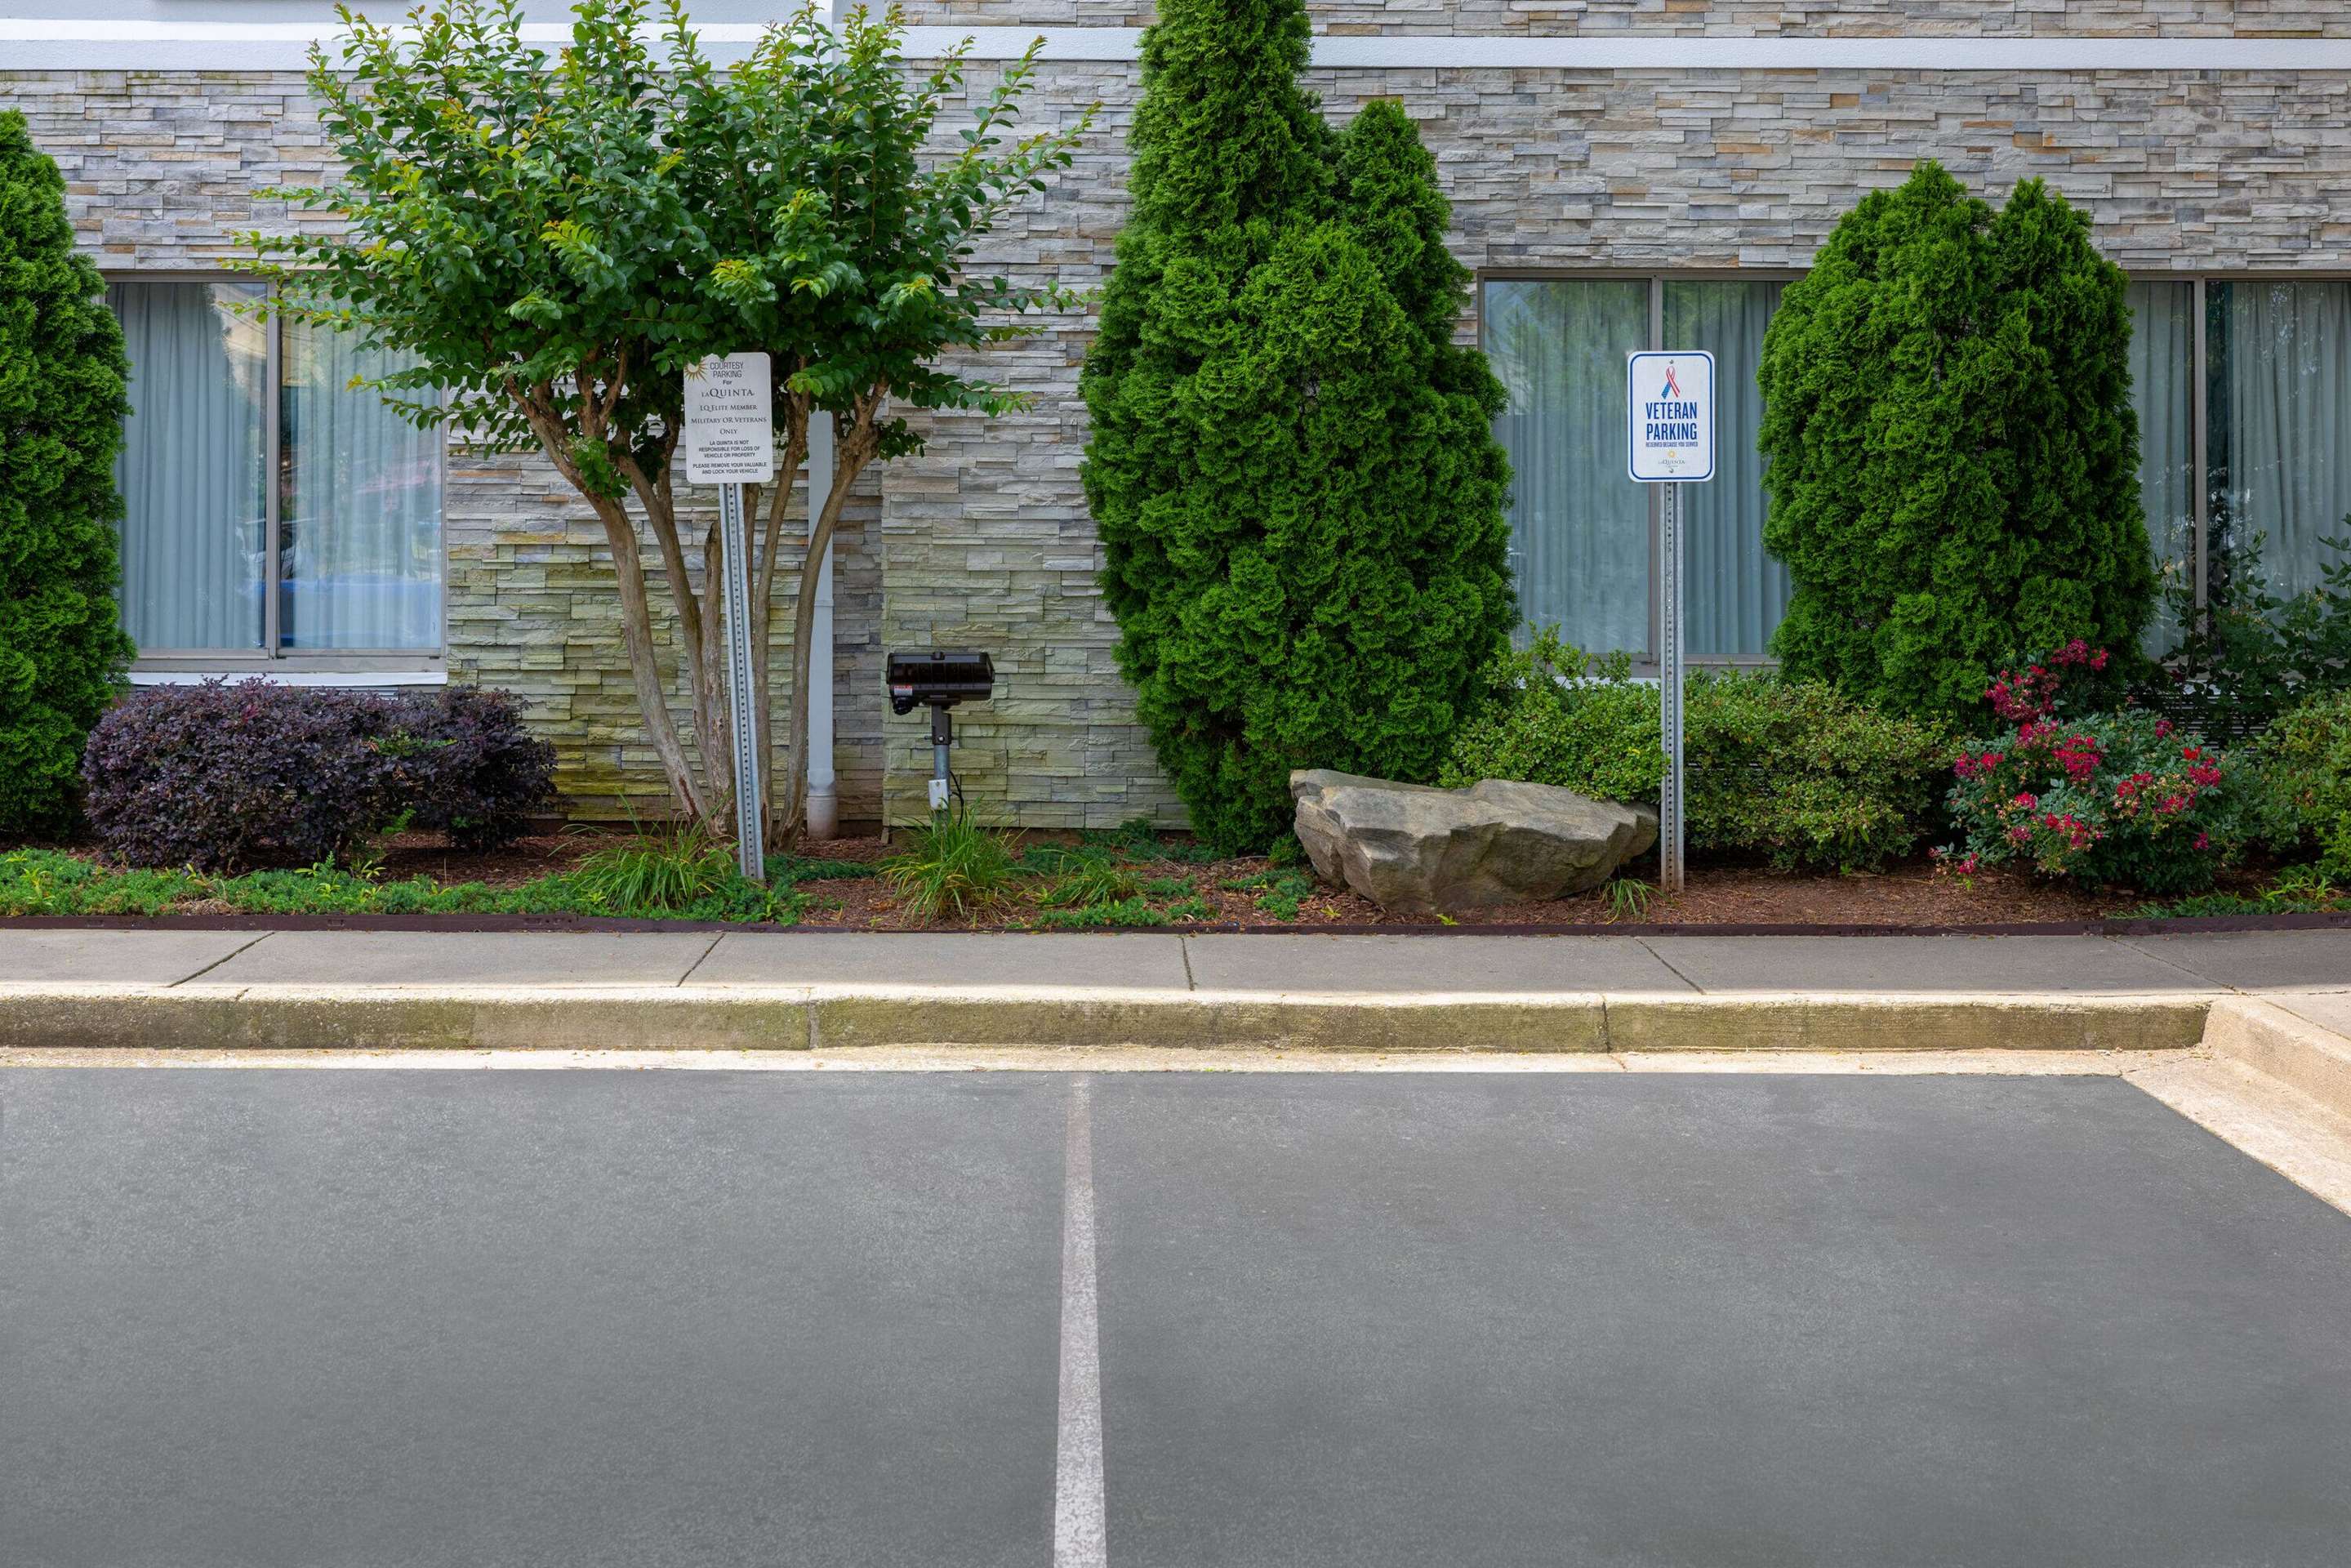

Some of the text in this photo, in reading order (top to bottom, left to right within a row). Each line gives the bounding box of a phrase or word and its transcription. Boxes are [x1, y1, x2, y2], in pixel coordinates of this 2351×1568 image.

[710, 362, 744, 370] COURTESY
[713, 370, 742, 378] PARKING
[1645, 402, 1698, 419] VETERAN
[1646, 423, 1698, 440] PARKING
